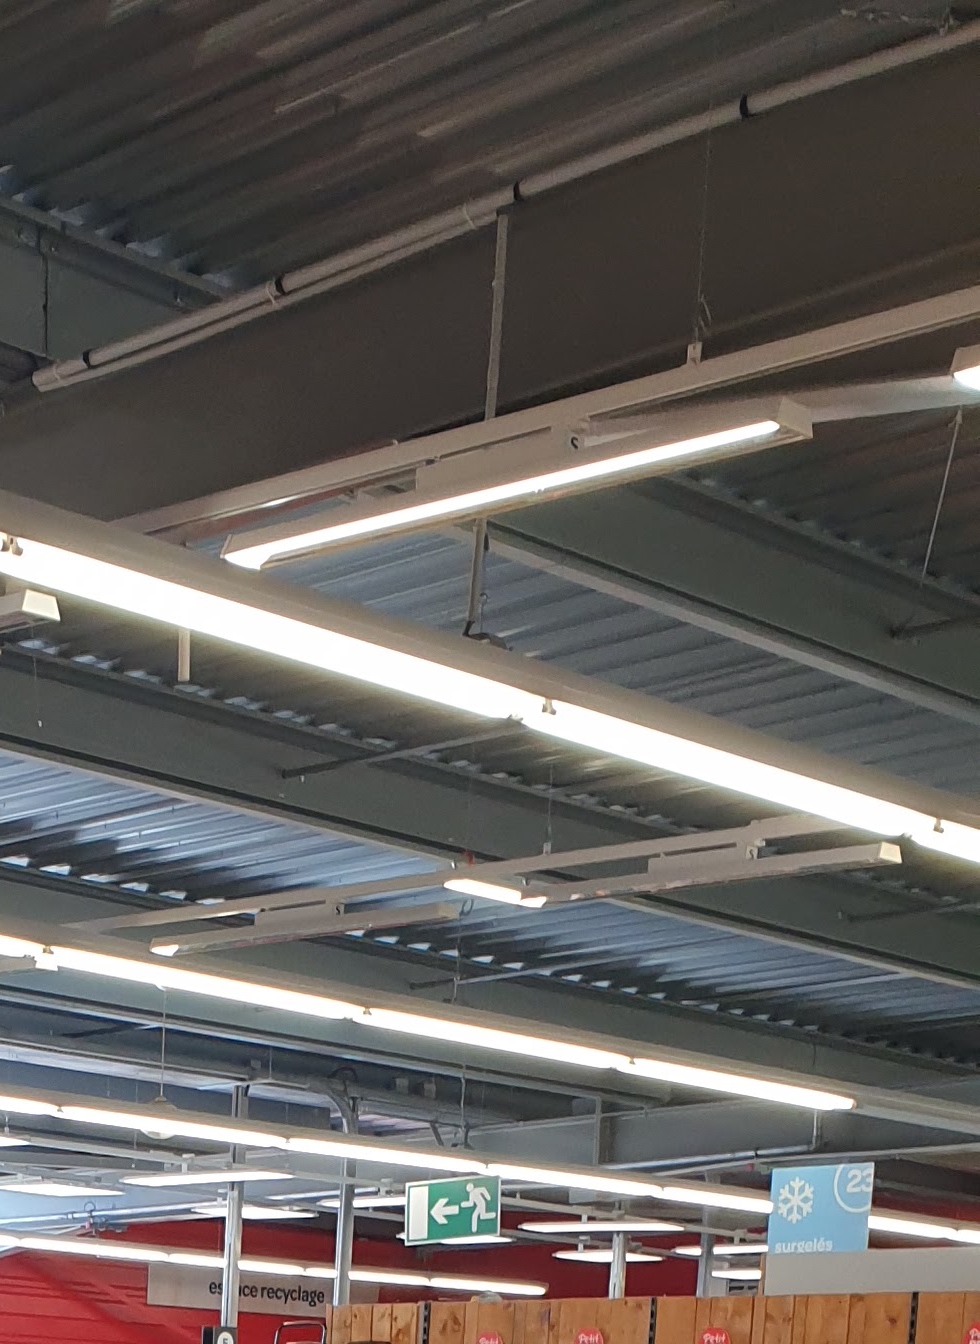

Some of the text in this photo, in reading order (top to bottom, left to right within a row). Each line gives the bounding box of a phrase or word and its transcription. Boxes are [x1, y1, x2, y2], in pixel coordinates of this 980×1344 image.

[774, 1237, 833, 1254] surgelés
[209, 1280, 325, 1307] esce recyclage
[578, 1332, 600, 1344] Petit
[702, 1332, 726, 1344] Petit
